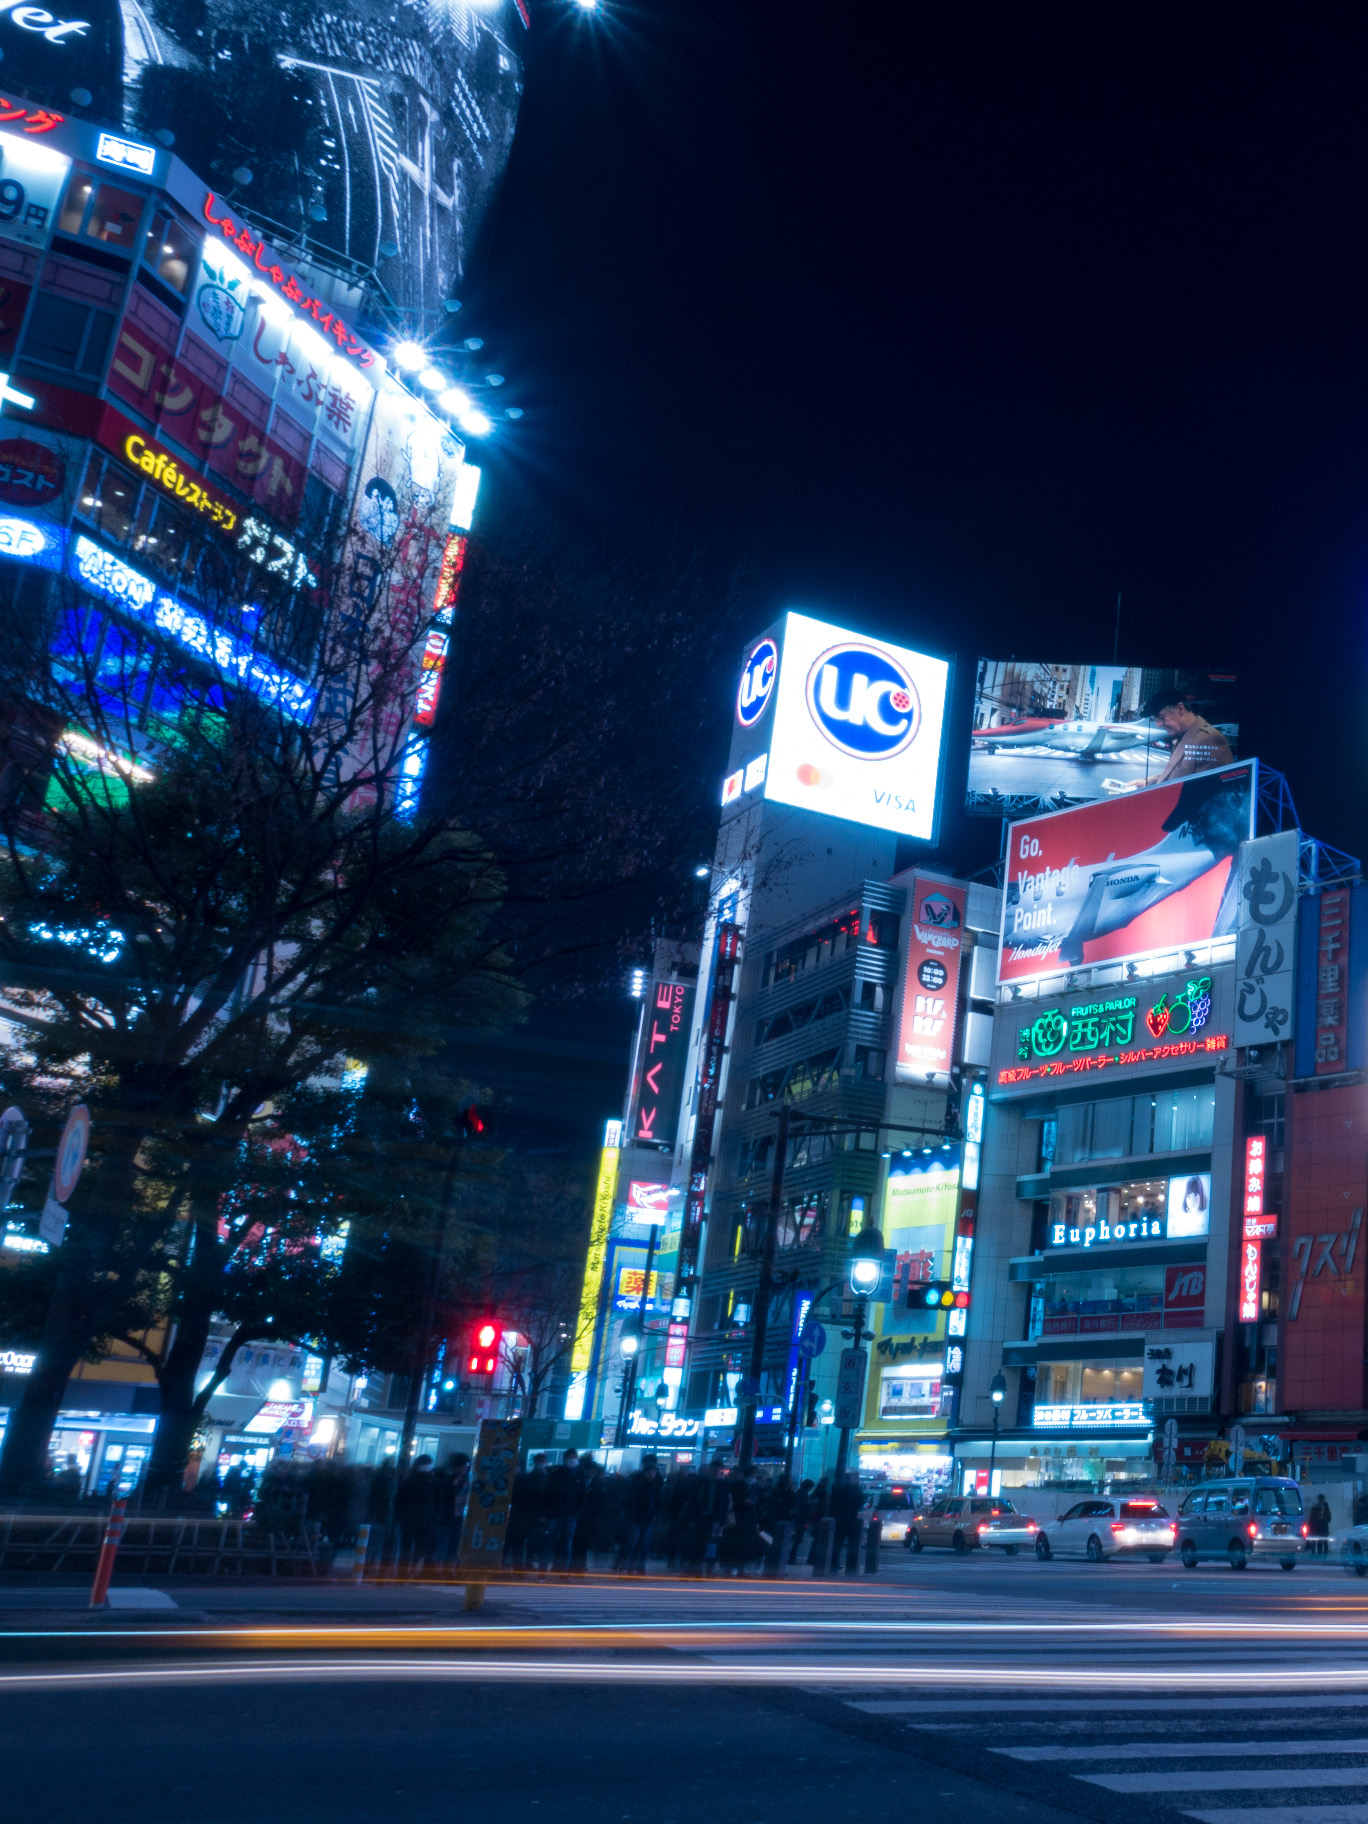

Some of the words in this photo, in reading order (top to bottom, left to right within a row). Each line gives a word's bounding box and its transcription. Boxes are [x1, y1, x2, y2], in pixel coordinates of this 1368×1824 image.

[205, 192, 375, 370] しゃぶしゃぶバイキング
[252, 315, 357, 433] しゃぶ葉
[112, 330, 294, 498] コンタクト
[873, 789, 916, 814] VISA
[1019, 834, 1043, 859] Go,
[1017, 863, 1080, 895] Vantage
[1106, 875, 1140, 887] HONDA
[1013, 902, 1057, 933] Point.
[913, 924, 960, 950] VANGUARD
[1238, 856, 1295, 1037] もんじゃ
[1315, 896, 1343, 1063] 三千里薬品
[669, 985, 685, 1032] TOKYO
[914, 994, 945, 1016] B1F
[1071, 997, 1137, 1017] FRUITS&PARLOR
[912, 1014, 945, 1037] B2F
[1069, 1011, 1135, 1052] 西村
[1017, 1028, 1031, 1060] 渋谷
[638, 983, 673, 1139] KATE
[890, 1184, 935, 1198] Matsumoto
[1053, 1216, 1161, 1247] Euphoria
[1287, 1206, 1364, 1321] クスリ
[1167, 1271, 1204, 1301] JTB
